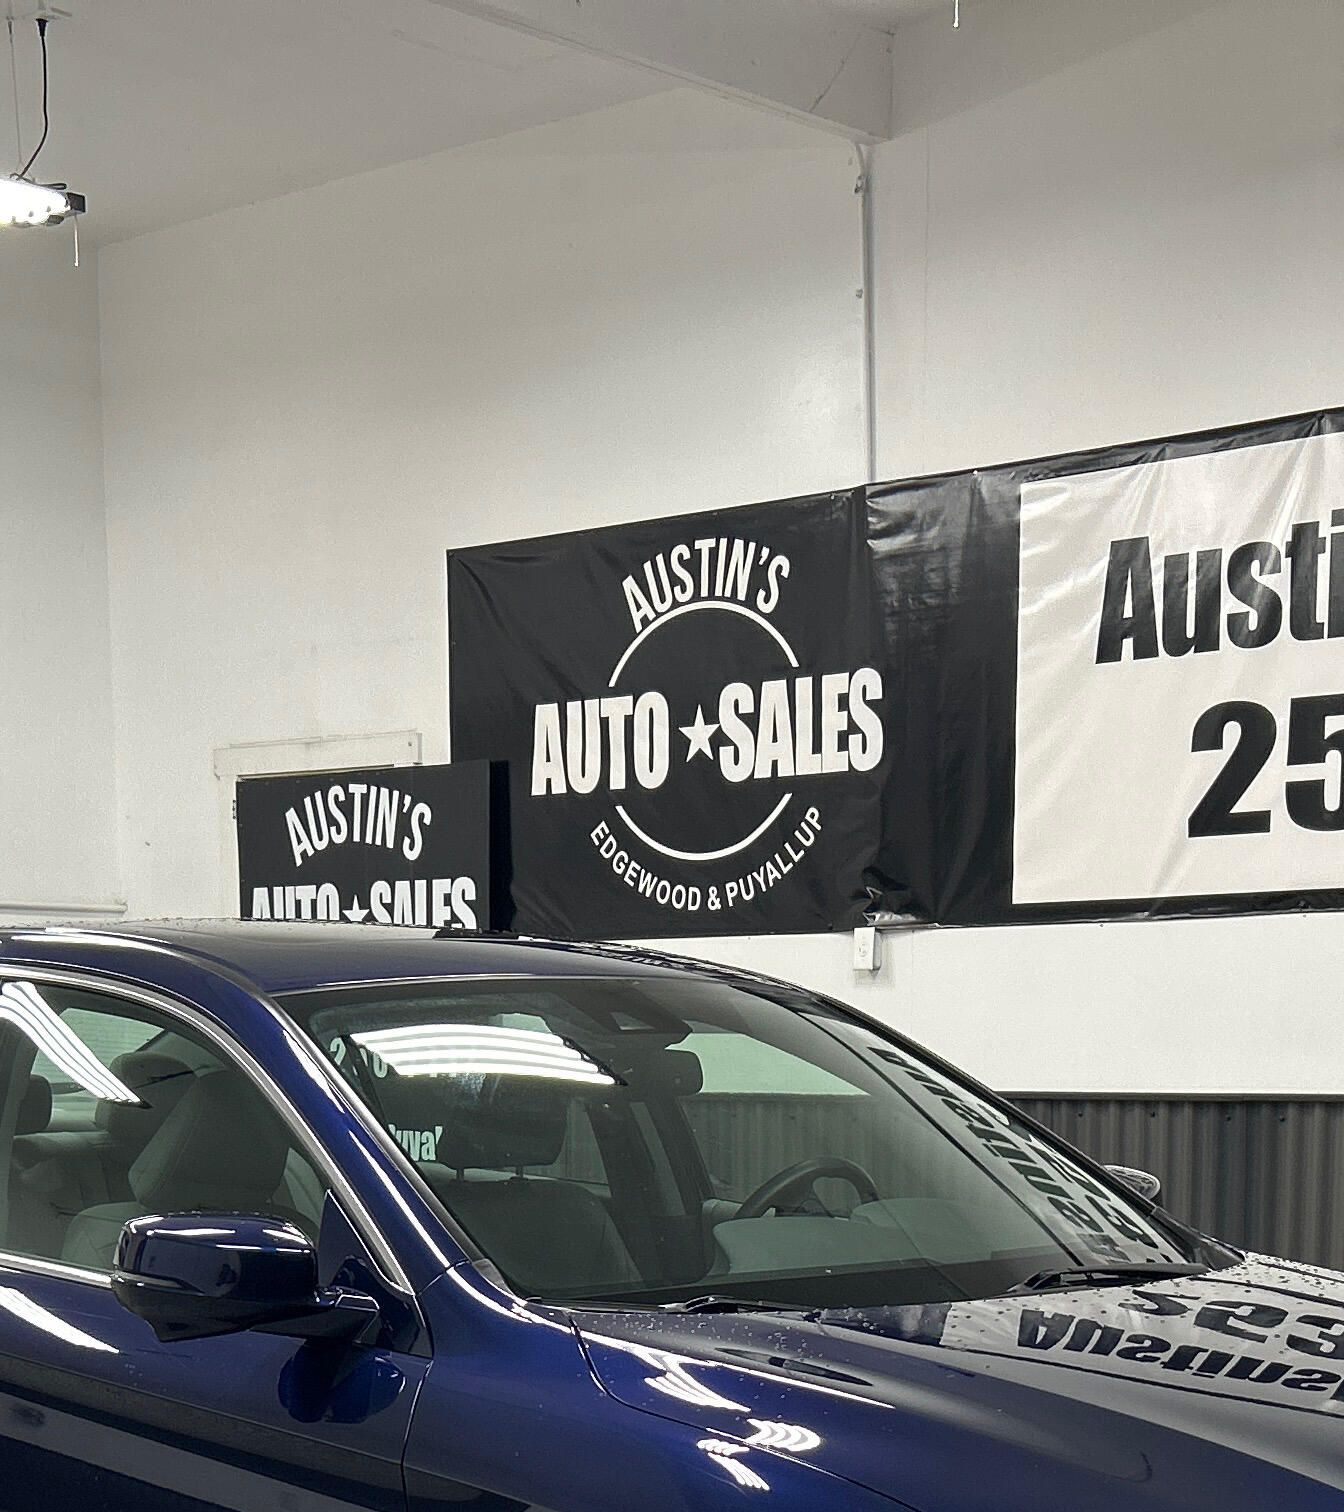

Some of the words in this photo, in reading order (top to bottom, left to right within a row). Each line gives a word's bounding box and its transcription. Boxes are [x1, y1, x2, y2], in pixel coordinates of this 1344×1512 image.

[622, 537, 790, 634] AUSTIN'S
[531, 691, 670, 797] AUTO
[718, 667, 884, 783] SALES
[285, 783, 432, 867] AUSTIN'S
[590, 820, 701, 911] EDGEWOOD
[707, 886, 722, 911] &
[725, 806, 823, 907] PUYALLUP
